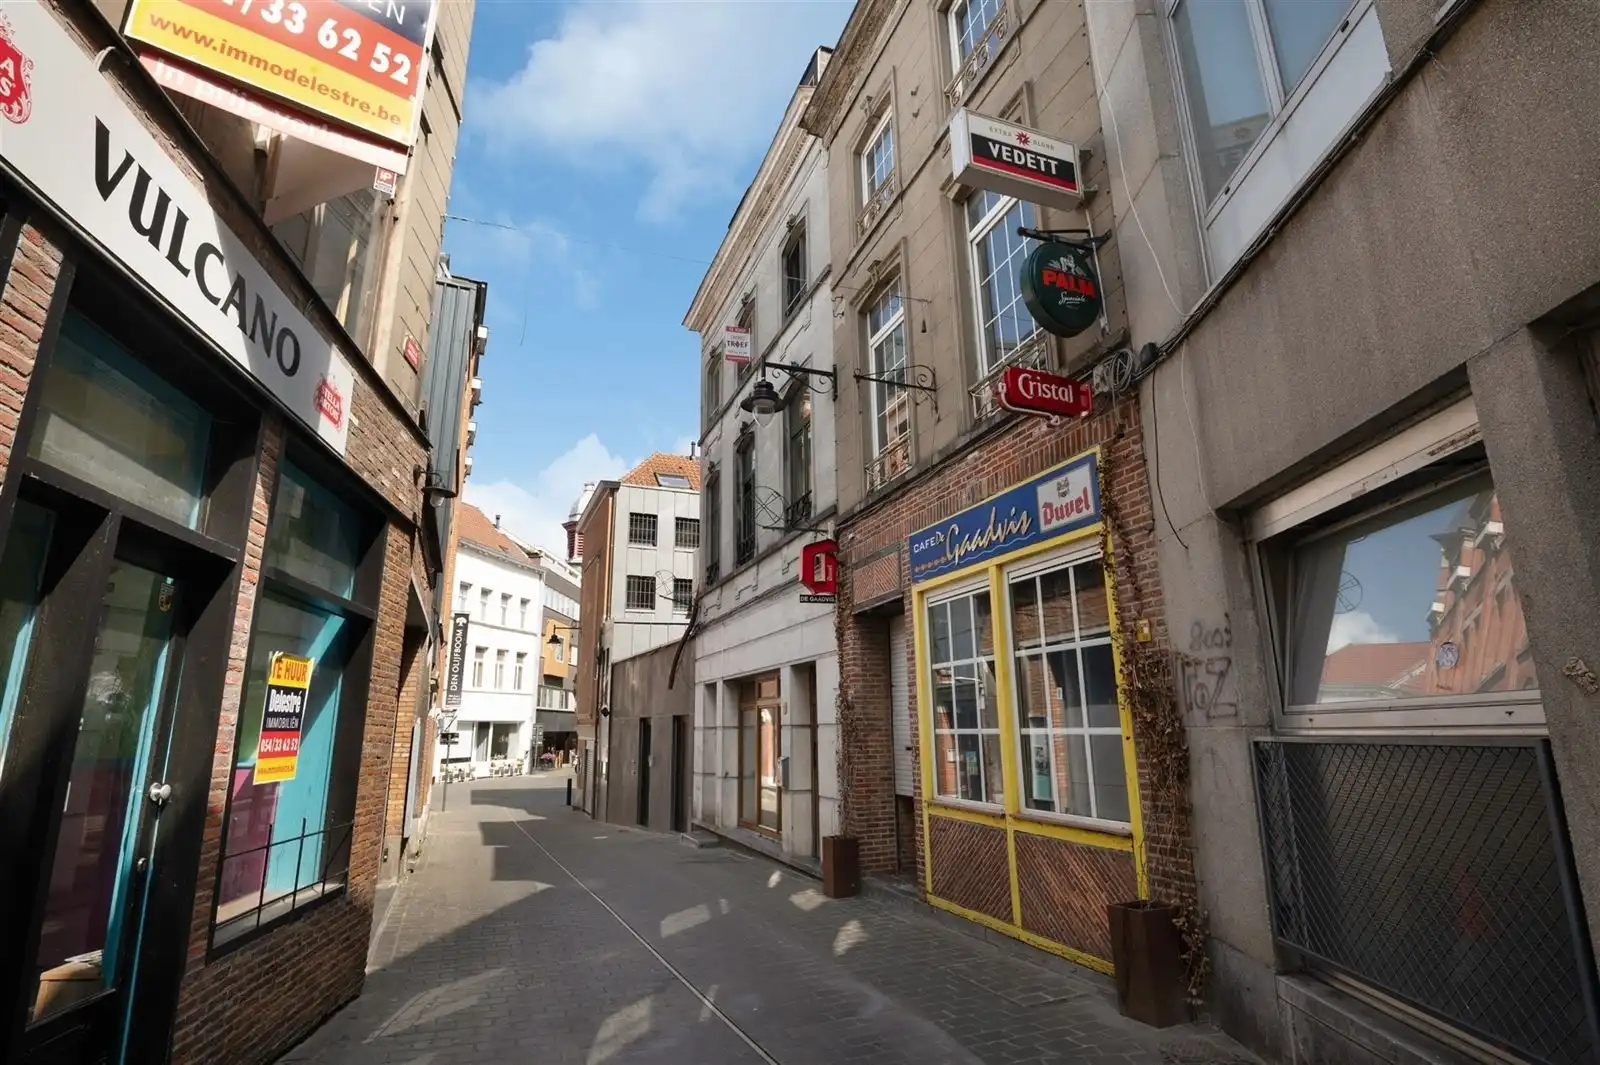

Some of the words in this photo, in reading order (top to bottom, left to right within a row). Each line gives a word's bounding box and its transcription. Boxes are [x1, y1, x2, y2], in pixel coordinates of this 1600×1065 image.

[318, 18, 362, 62] 62
[370, 42, 411, 86] 52
[149, 13, 402, 126] www.immodelestre.be
[988, 126, 1012, 137] EXTRA
[987, 141, 1059, 175] VEDETT
[94, 114, 301, 378] VULCANO
[1042, 269, 1097, 299] PALM
[1018, 373, 1073, 404] Cristal
[1042, 487, 1091, 525] Duvel
[913, 536, 936, 553] CAFE
[946, 507, 1034, 566] Gaadvis
[451, 629, 464, 671] OLIJFBOOM
[284, 661, 307, 681] HUUR
[449, 673, 459, 692] DEN
[269, 689, 302, 713] Delestré
[260, 738, 282, 753] 054/33
[282, 738, 291, 751] 62
[291, 738, 299, 750] 52
